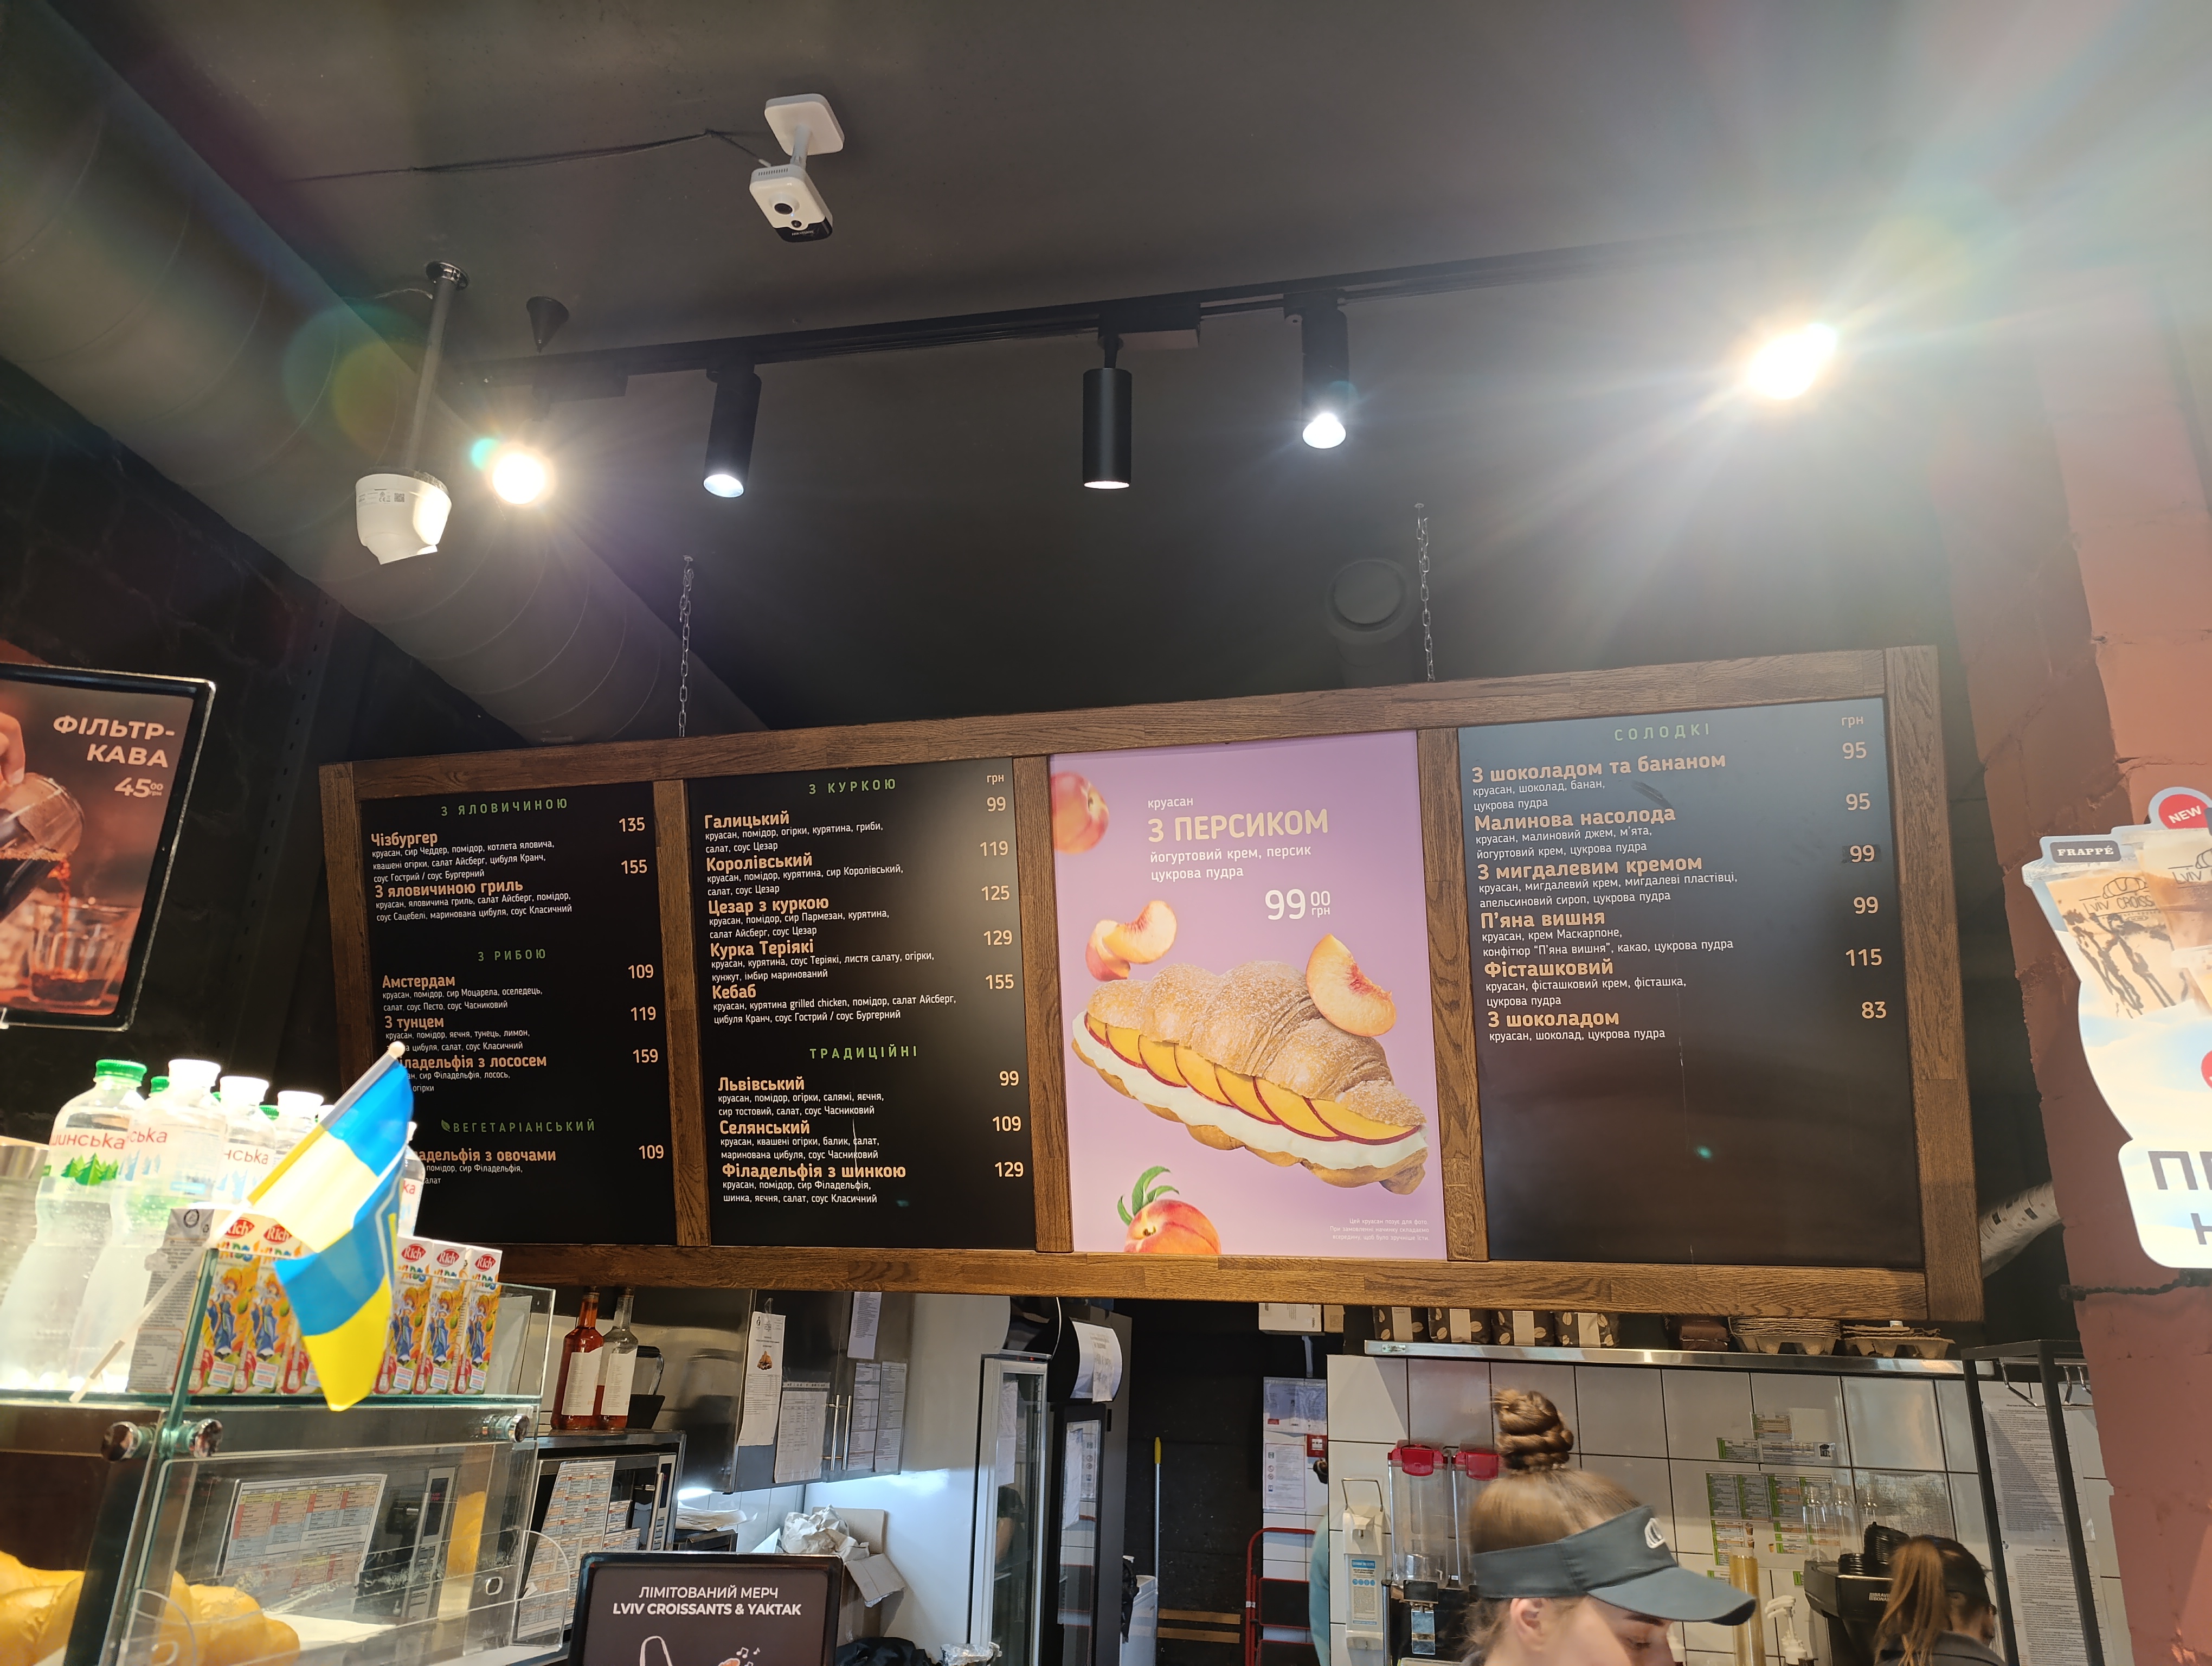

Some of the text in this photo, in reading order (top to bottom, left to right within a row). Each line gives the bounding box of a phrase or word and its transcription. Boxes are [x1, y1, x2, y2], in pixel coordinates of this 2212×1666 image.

[54, 715, 175, 740] ФІЛЬТР-
[1841, 716, 1863, 728] грн
[1615, 723, 1709, 741] СОЛОДКІ
[87, 744, 168, 768] КАВА
[1842, 741, 1867, 759] 95
[1471, 755, 1726, 783] З шоколадом та бананом
[114, 777, 151, 798] 45
[809, 778, 896, 794] З КУРКОЮ
[987, 774, 1004, 785] грн
[441, 798, 567, 816] З ЯЛОВИЧИНОЮ
[987, 796, 1006, 812] 99
[1148, 797, 1193, 811] круасан
[1846, 792, 1870, 811] 95
[704, 810, 789, 829] Галицький
[1475, 808, 1676, 832] Малинова насолода
[2168, 805, 2202, 824] NEW
[619, 816, 646, 832] 135
[1148, 808, 1328, 843] З ПЕРСИКОМ
[371, 831, 438, 849] Чізбургер
[371, 841, 555, 860] круасан, сир Чеддер, помідор, котлета яловича,
[980, 841, 1008, 857] 119
[1150, 846, 1311, 865] йогуртовий крем, персик
[1849, 844, 1875, 863] 99
[2057, 845, 2114, 856] FRAPPÉ
[621, 859, 648, 875] 155
[706, 851, 813, 875] Королівський
[1477, 857, 1702, 881] З мигдалевим кремом
[1151, 867, 1244, 883] цукрова пудра
[1478, 872, 1738, 895] круасан, мигдалевий крем, мигдалеві пластівці,
[375, 881, 524, 898] З яловичиною гриль
[981, 885, 1010, 901] 125
[1310, 890, 1330, 906] 00
[708, 898, 829, 917] Цезар з куркою
[1265, 888, 1306, 920] 99
[1311, 907, 1330, 918] грн
[1853, 896, 1879, 914] 99
[1481, 912, 1605, 929] П’яна вишня
[983, 930, 1012, 946] 129
[478, 949, 546, 962] З РИБОЮ
[710, 938, 814, 960] Курка Теріякі
[1845, 948, 1882, 967] 115
[627, 964, 654, 979] 109
[1484, 958, 1613, 978] Фісташковий
[382, 975, 455, 991] Амстердам
[985, 973, 1014, 990] 155
[382, 988, 543, 1001] круасан, помідор, сир Моцарела, оселедець,
[712, 983, 757, 999] Кебаб
[713, 994, 956, 1013] круасан, курятина grilled chicken, помідор, салат Айсберг,
[1861, 1001, 1887, 1019] 83
[630, 1006, 657, 1021] 119
[1487, 1011, 1619, 1029] З шоколадом
[384, 1015, 444, 1032] З тунцем
[632, 1048, 659, 1063] 159
[809, 1043, 917, 1061] ТРАДИЦІЙНІ
[400, 1054, 547, 1072] іладельфія з лососем
[717, 1075, 805, 1092] Львівський
[999, 1070, 1019, 1086] 99
[718, 1091, 884, 1105] круасан, помідор, огірки, салямі, яєчня,
[453, 1118, 595, 1132] ВЕГЕТАРІАНСЬКИЙ
[719, 1119, 810, 1135] Селянський
[992, 1116, 1021, 1132] 109
[418, 1147, 556, 1165] адельфія з овочами
[638, 1144, 664, 1159] 109
[722, 1163, 906, 1182] Філадельфія з шинкою
[994, 1161, 1024, 1177] 129
[639, 1584, 779, 1599] ЛІМІТОВАНИЙ МЕРЧ
[613, 1603, 801, 1616] LVIV CROISSANTS & YAKTAK
